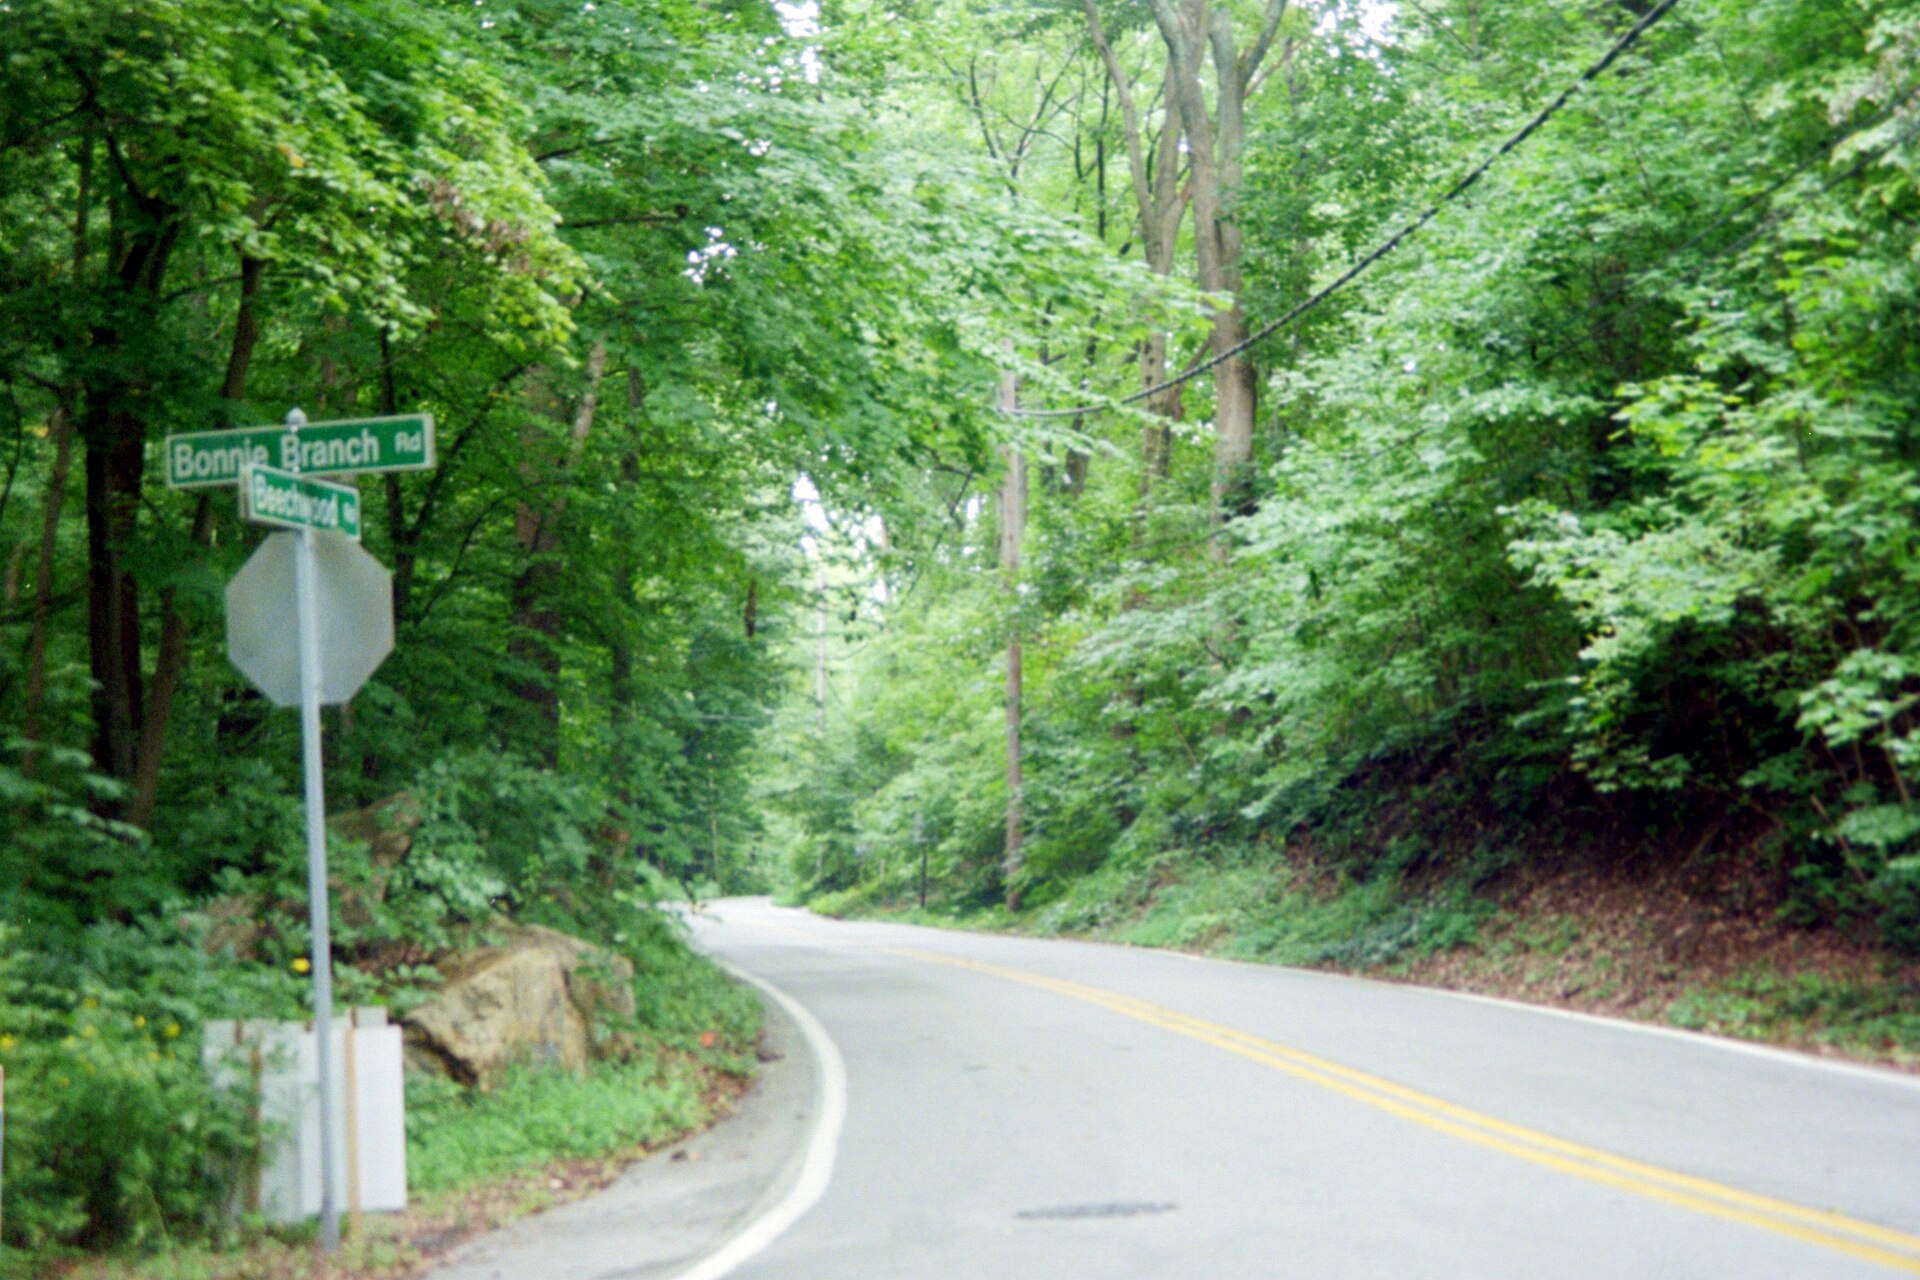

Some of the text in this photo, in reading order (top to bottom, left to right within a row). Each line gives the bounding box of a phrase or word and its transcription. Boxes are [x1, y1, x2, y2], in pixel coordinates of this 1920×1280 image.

[174, 427, 422, 478] Bonnie Branch Rd
